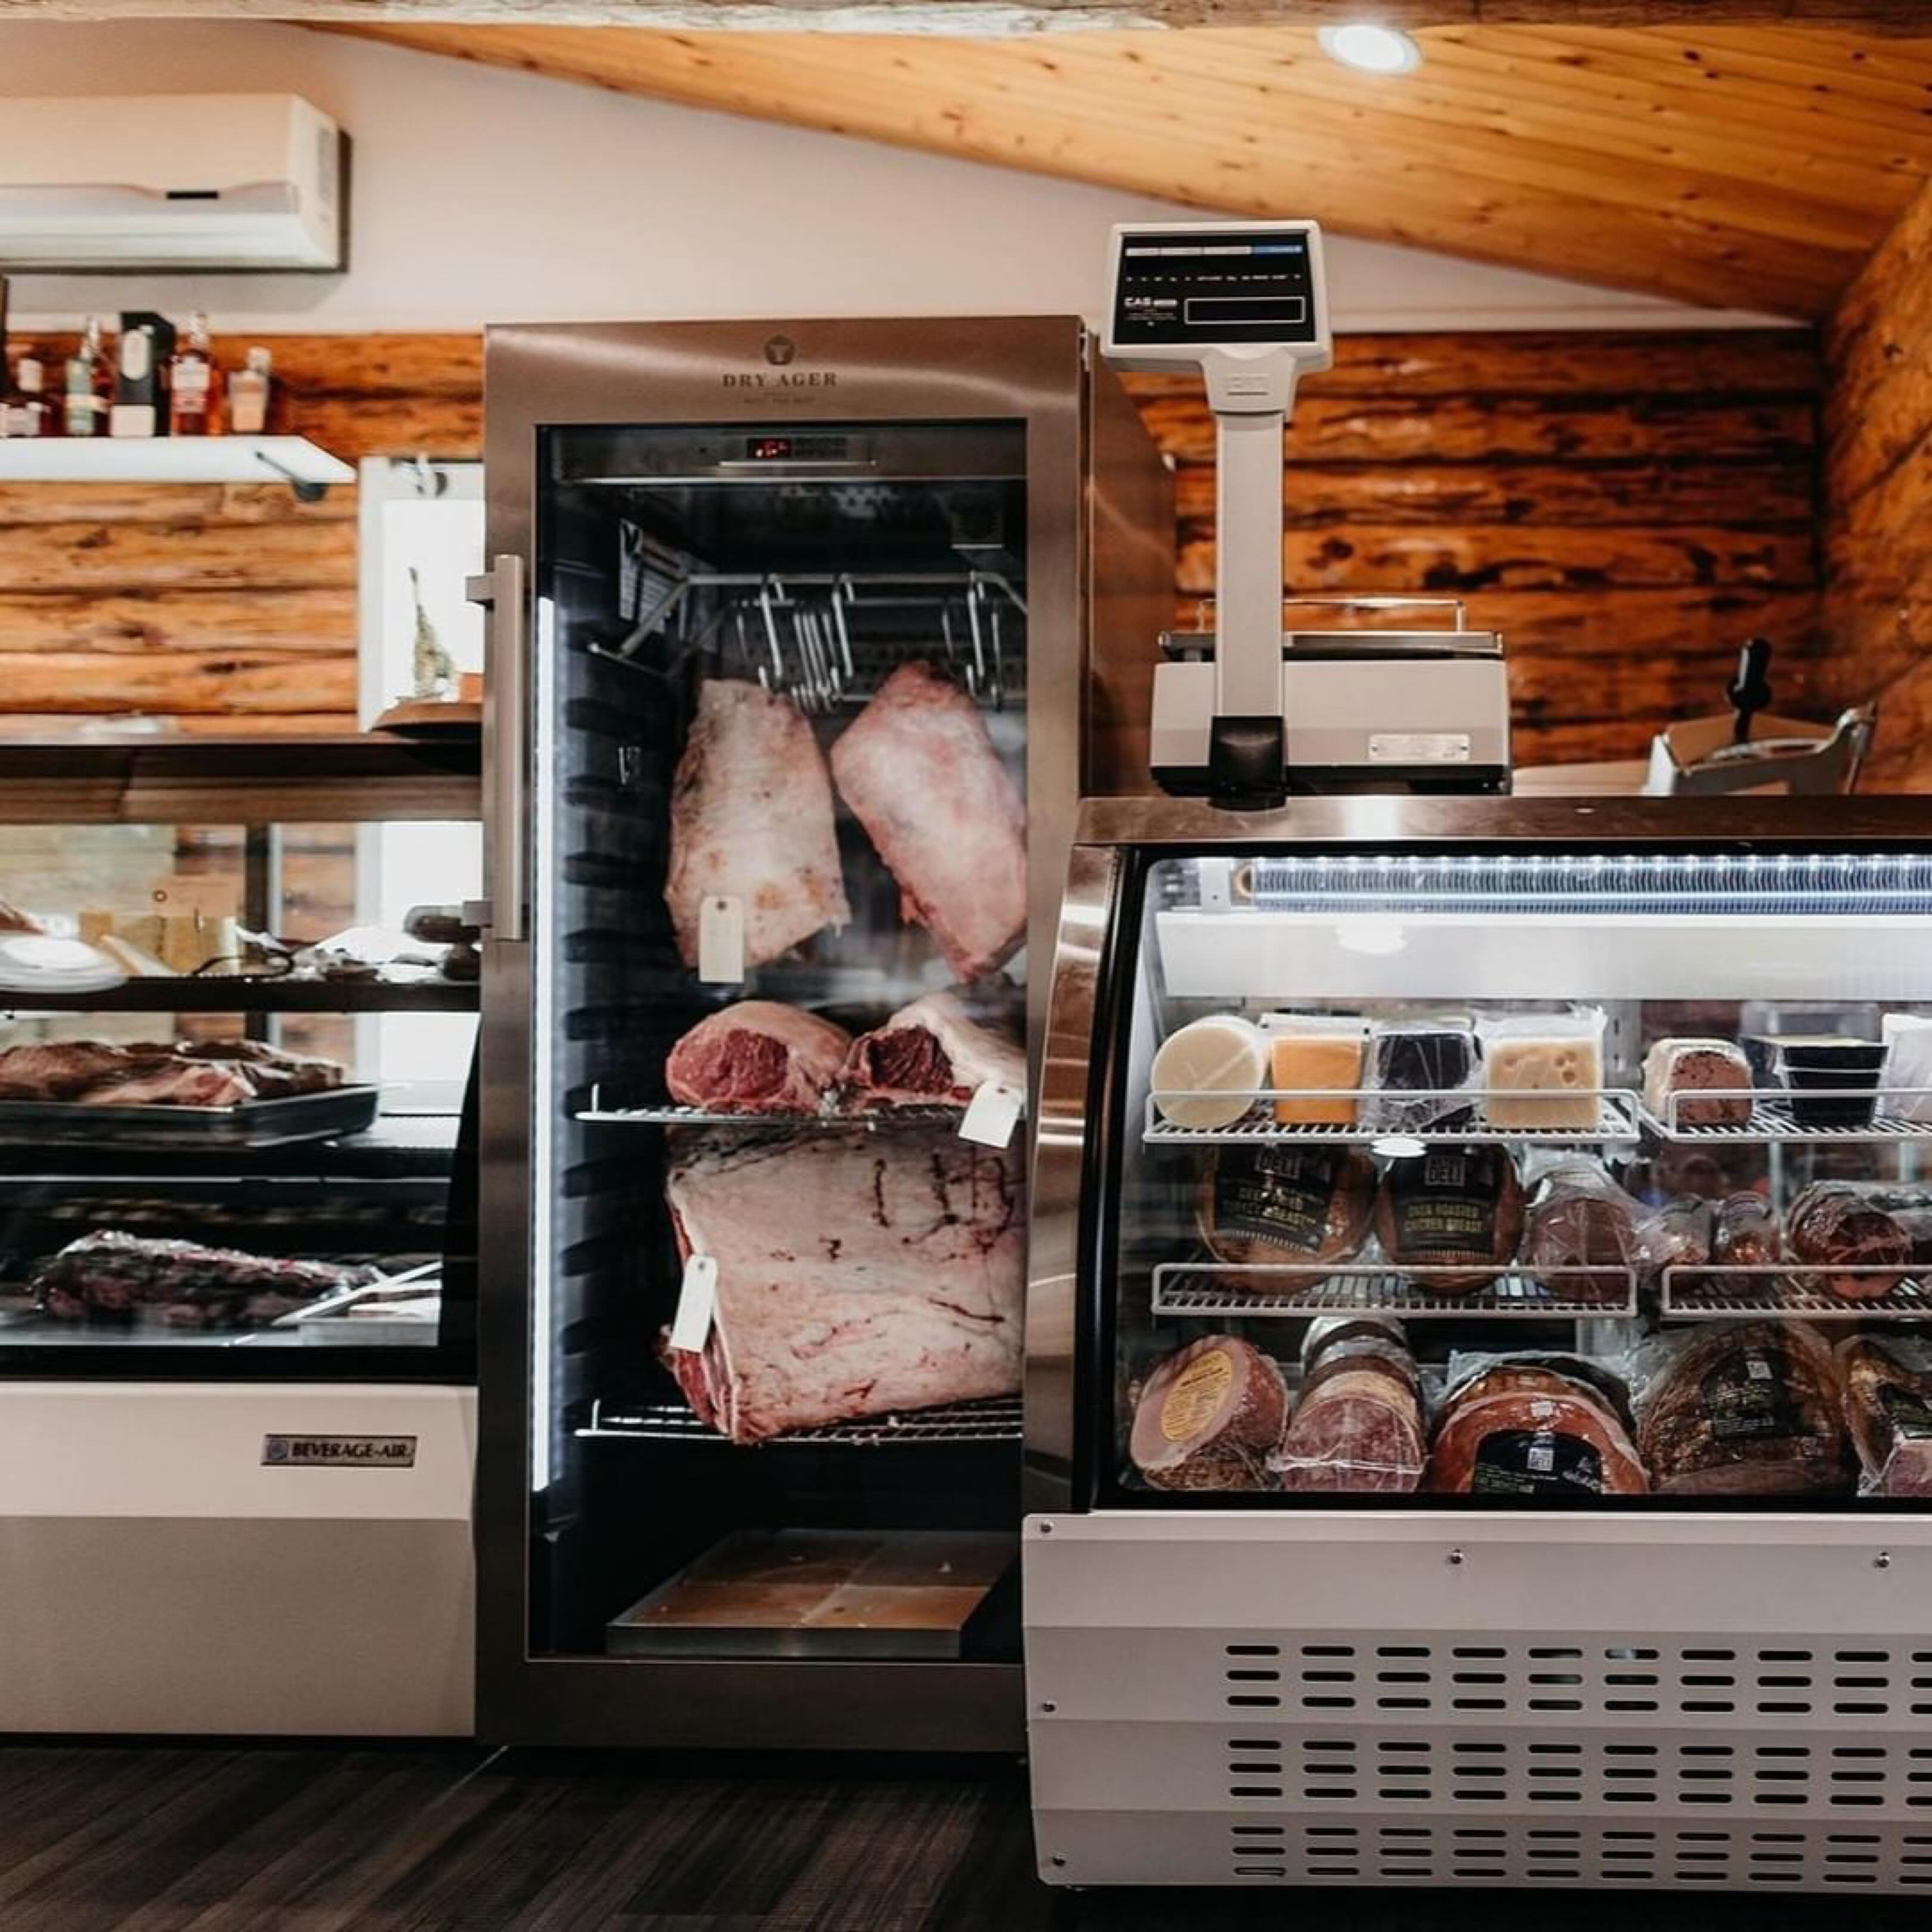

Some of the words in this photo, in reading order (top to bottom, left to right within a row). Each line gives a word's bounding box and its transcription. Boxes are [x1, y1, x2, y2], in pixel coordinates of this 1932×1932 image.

[1124, 296, 1151, 307] CAS
[722, 373, 768, 387] DRY
[777, 372, 837, 387] AGER
[1435, 1202, 1480, 1219] ROASTED
